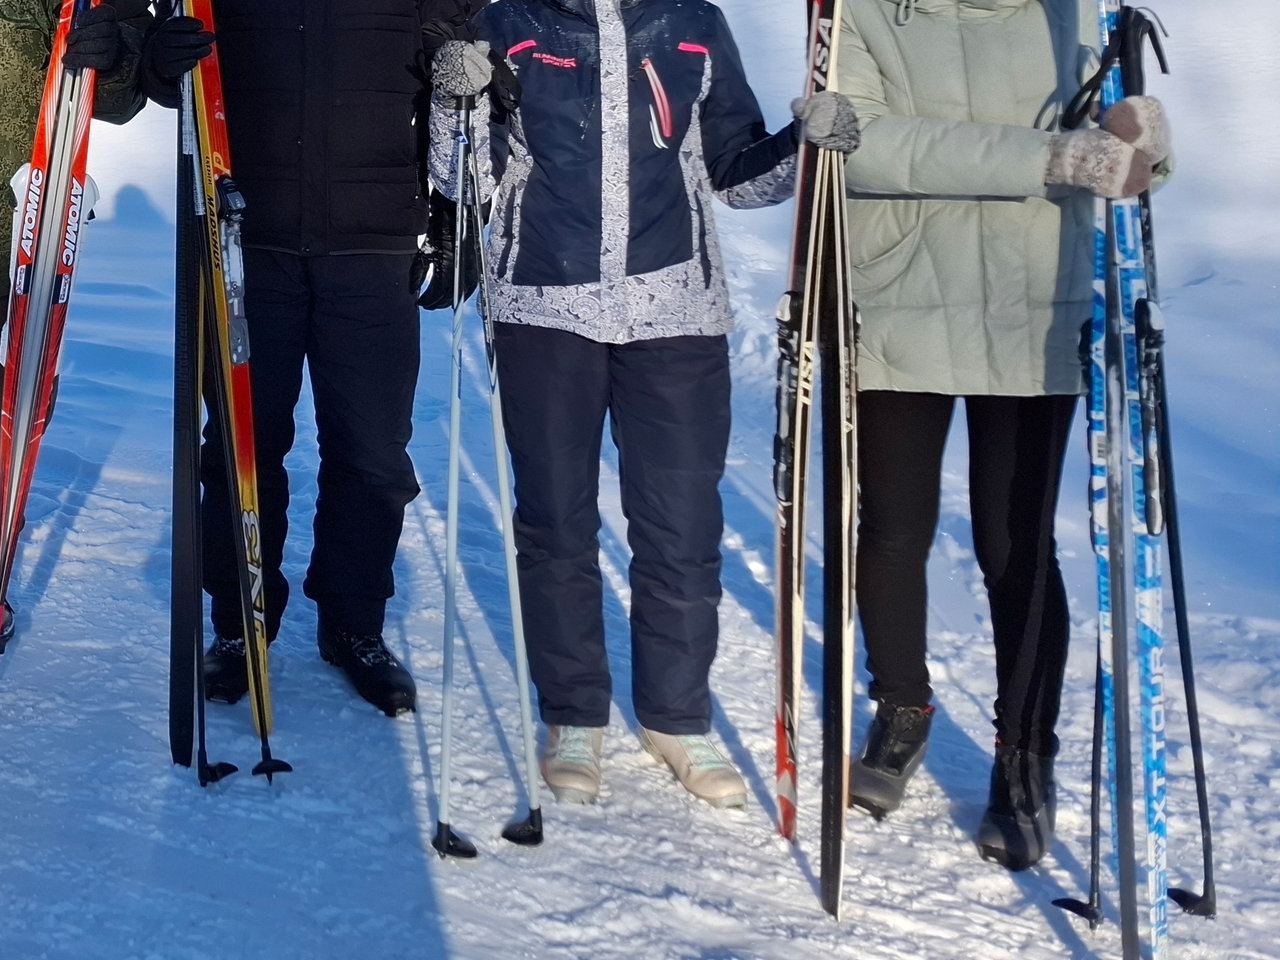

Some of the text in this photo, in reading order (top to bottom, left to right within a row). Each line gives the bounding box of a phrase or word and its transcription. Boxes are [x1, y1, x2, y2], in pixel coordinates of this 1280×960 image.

[21, 168, 42, 258] ATOMIC
[62, 176, 82, 267] ATOMIC
[207, 194, 220, 271] MADSHUS
